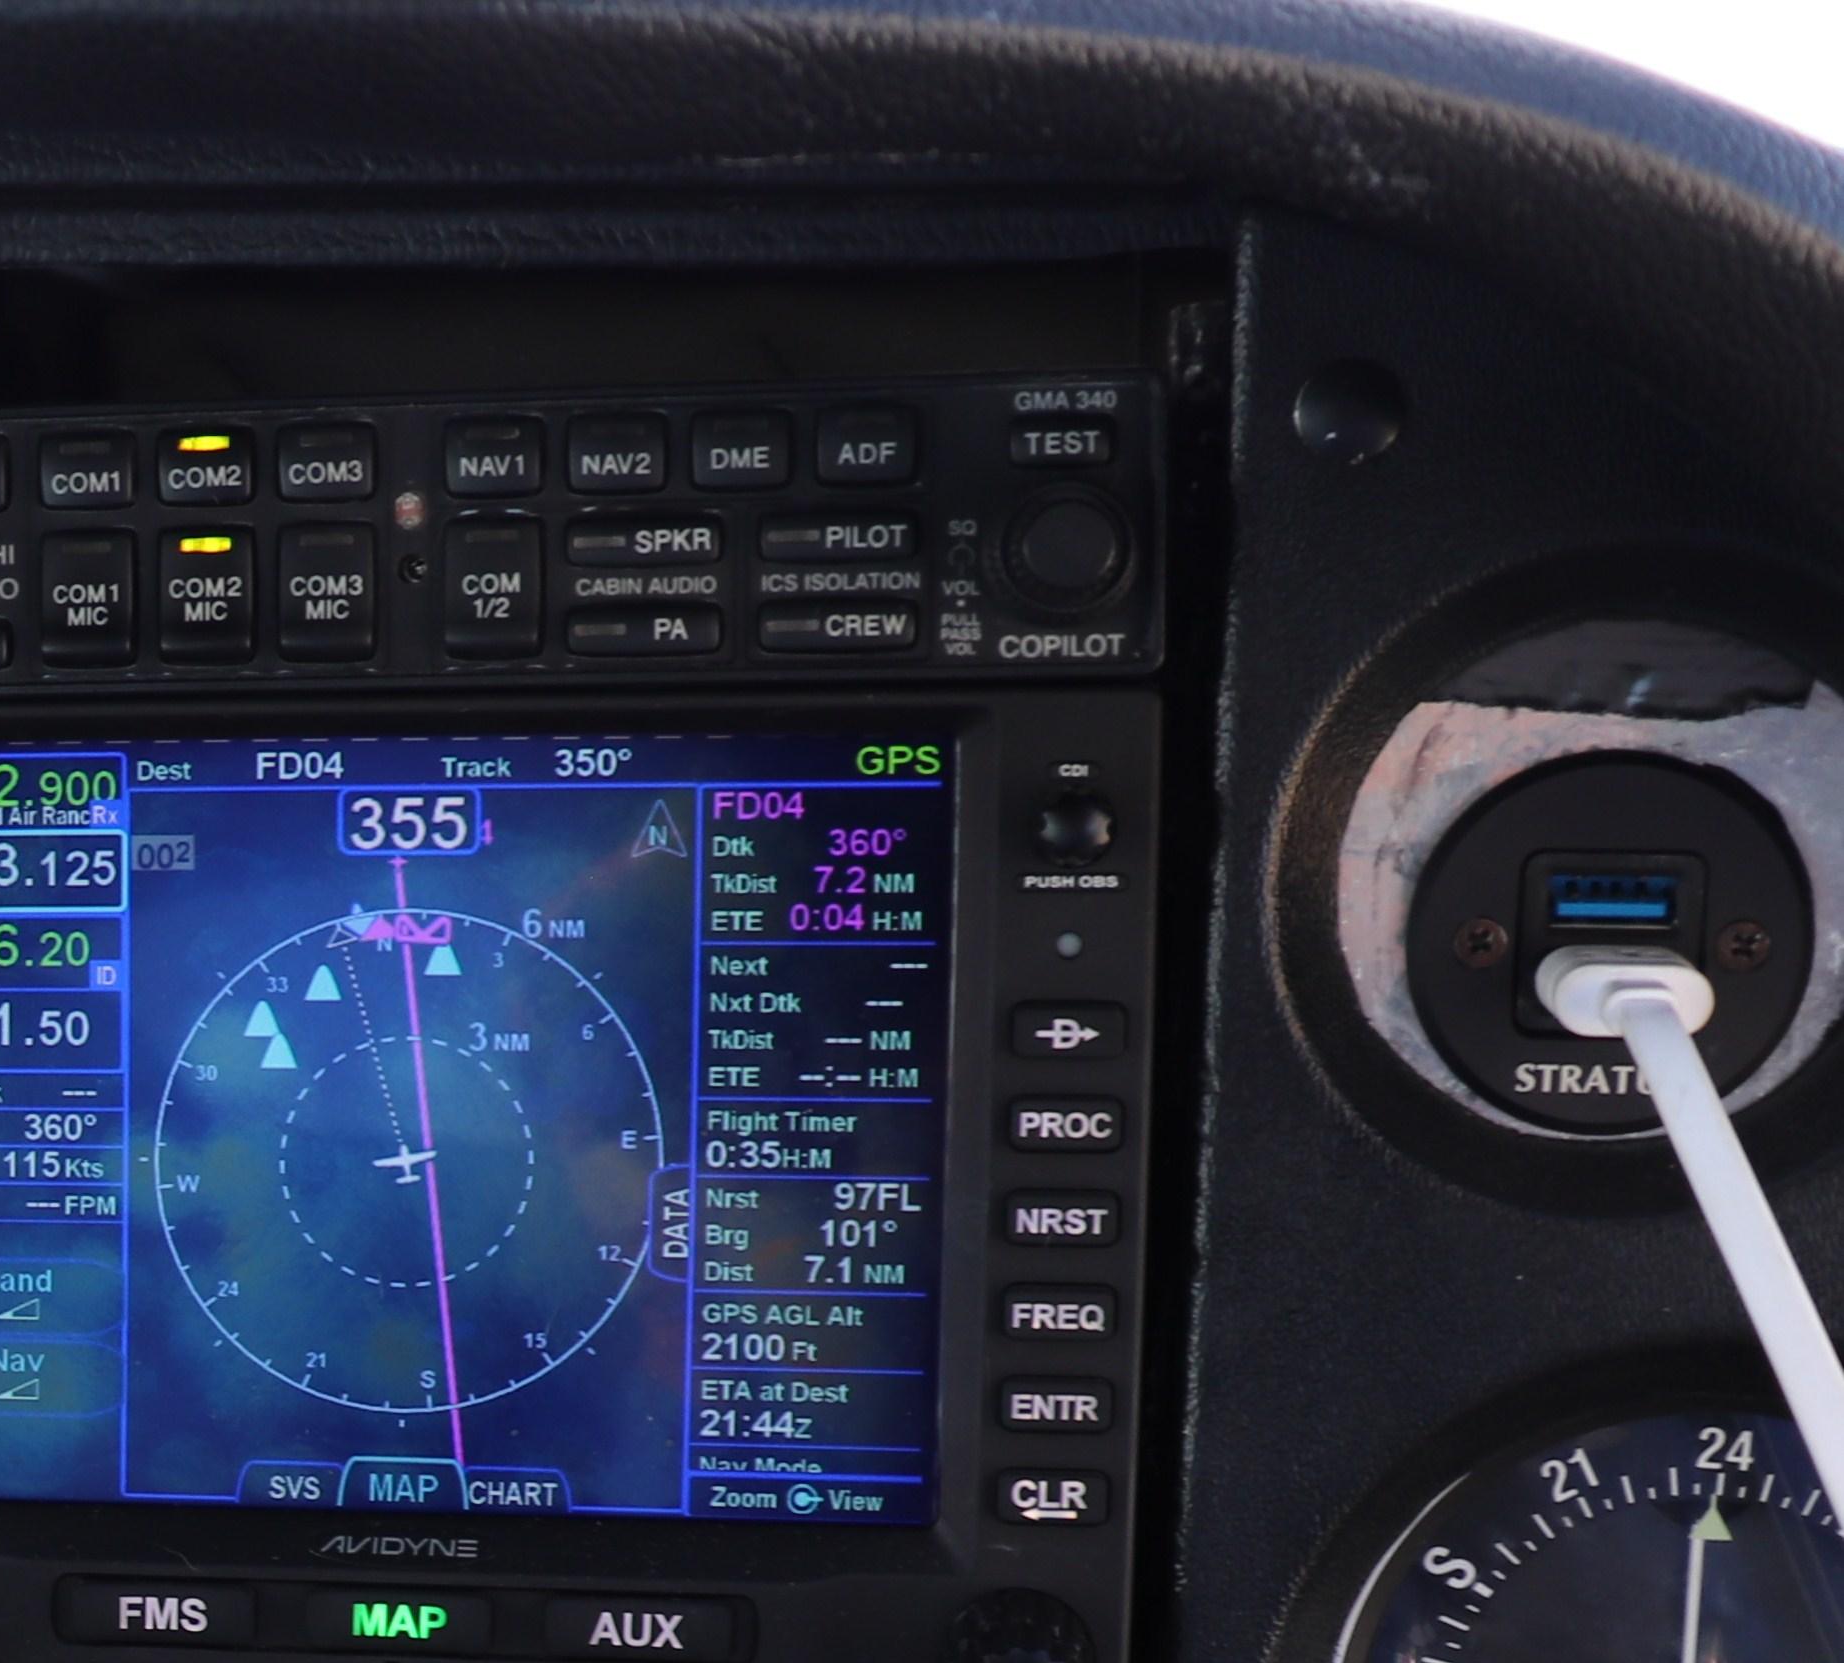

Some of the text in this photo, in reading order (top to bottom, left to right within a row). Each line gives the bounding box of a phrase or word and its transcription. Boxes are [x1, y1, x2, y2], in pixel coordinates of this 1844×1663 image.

[1015, 390, 1117, 411] GMA 340
[837, 442, 895, 465] ADF
[1024, 432, 1100, 454] TEST
[460, 454, 525, 477] NAV1
[582, 452, 651, 475] NAV2
[711, 448, 769, 469] DME
[52, 471, 121, 494] COM1
[168, 466, 241, 489] COM2
[288, 461, 362, 484] COM3
[634, 529, 711, 552] SPKR
[825, 526, 906, 548] PILOT
[575, 575, 717, 596] CABIN AUDIO
[762, 571, 921, 592] ICS ISOLATION
[653, 618, 687, 641] PA
[825, 614, 906, 638] CREW
[999, 634, 1124, 658] COPILOT
[136, 752, 344, 781] Dest FD04
[441, 748, 632, 778] Track 350°
[857, 746, 941, 775] GPS
[1059, 765, 1088, 777] CDI
[9, 808, 37, 825] Air
[351, 797, 467, 849] 355
[713, 829, 906, 856] Dtk 360°
[711, 867, 914, 894] TkDist 7.2 NM
[1024, 875, 1118, 888] PUSH OBS
[708, 1110, 857, 1137] Flight Timer
[1019, 1112, 1112, 1138] PROC
[705, 1183, 920, 1212] Nrst 97FL
[1017, 1209, 1108, 1234] NRST
[703, 1304, 863, 1326] GPS AGL Alt
[1011, 1303, 1105, 1331] FREQ
[701, 1381, 848, 1402] ETA at Dest
[1011, 1395, 1097, 1421] ENTR
[269, 1476, 321, 1499] SVS
[369, 1474, 439, 1502] MAP
[469, 1481, 558, 1505] CHART
[710, 1487, 883, 1511] Zoom View
[1011, 1480, 1087, 1509] CLR
[320, 1534, 479, 1558] AVIDYNE
[118, 1597, 207, 1631] FMS
[352, 1602, 447, 1639] MAP
[589, 1613, 684, 1648] AUX
